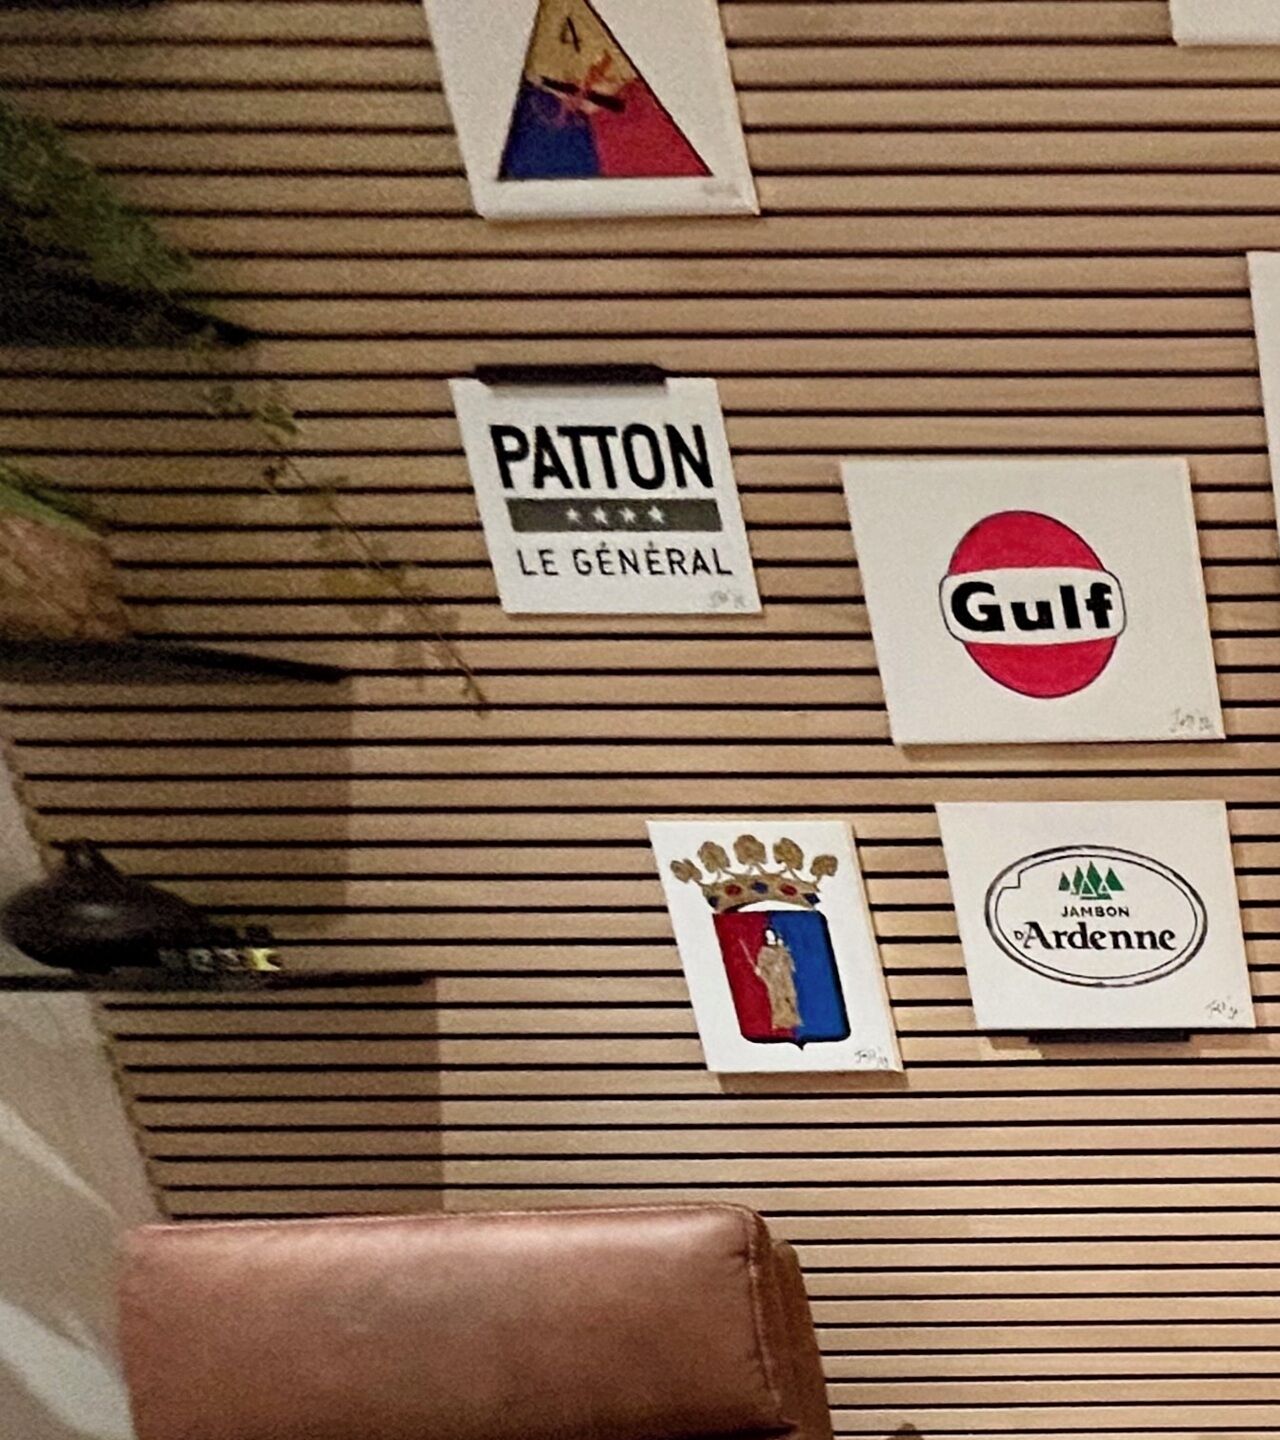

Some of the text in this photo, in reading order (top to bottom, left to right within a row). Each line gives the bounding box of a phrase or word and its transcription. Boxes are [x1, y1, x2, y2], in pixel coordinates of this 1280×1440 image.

[489, 423, 714, 490] PATTON
[516, 549, 559, 576] LE
[949, 580, 1114, 632] Gulf
[1061, 905, 1130, 918] JAMBON
